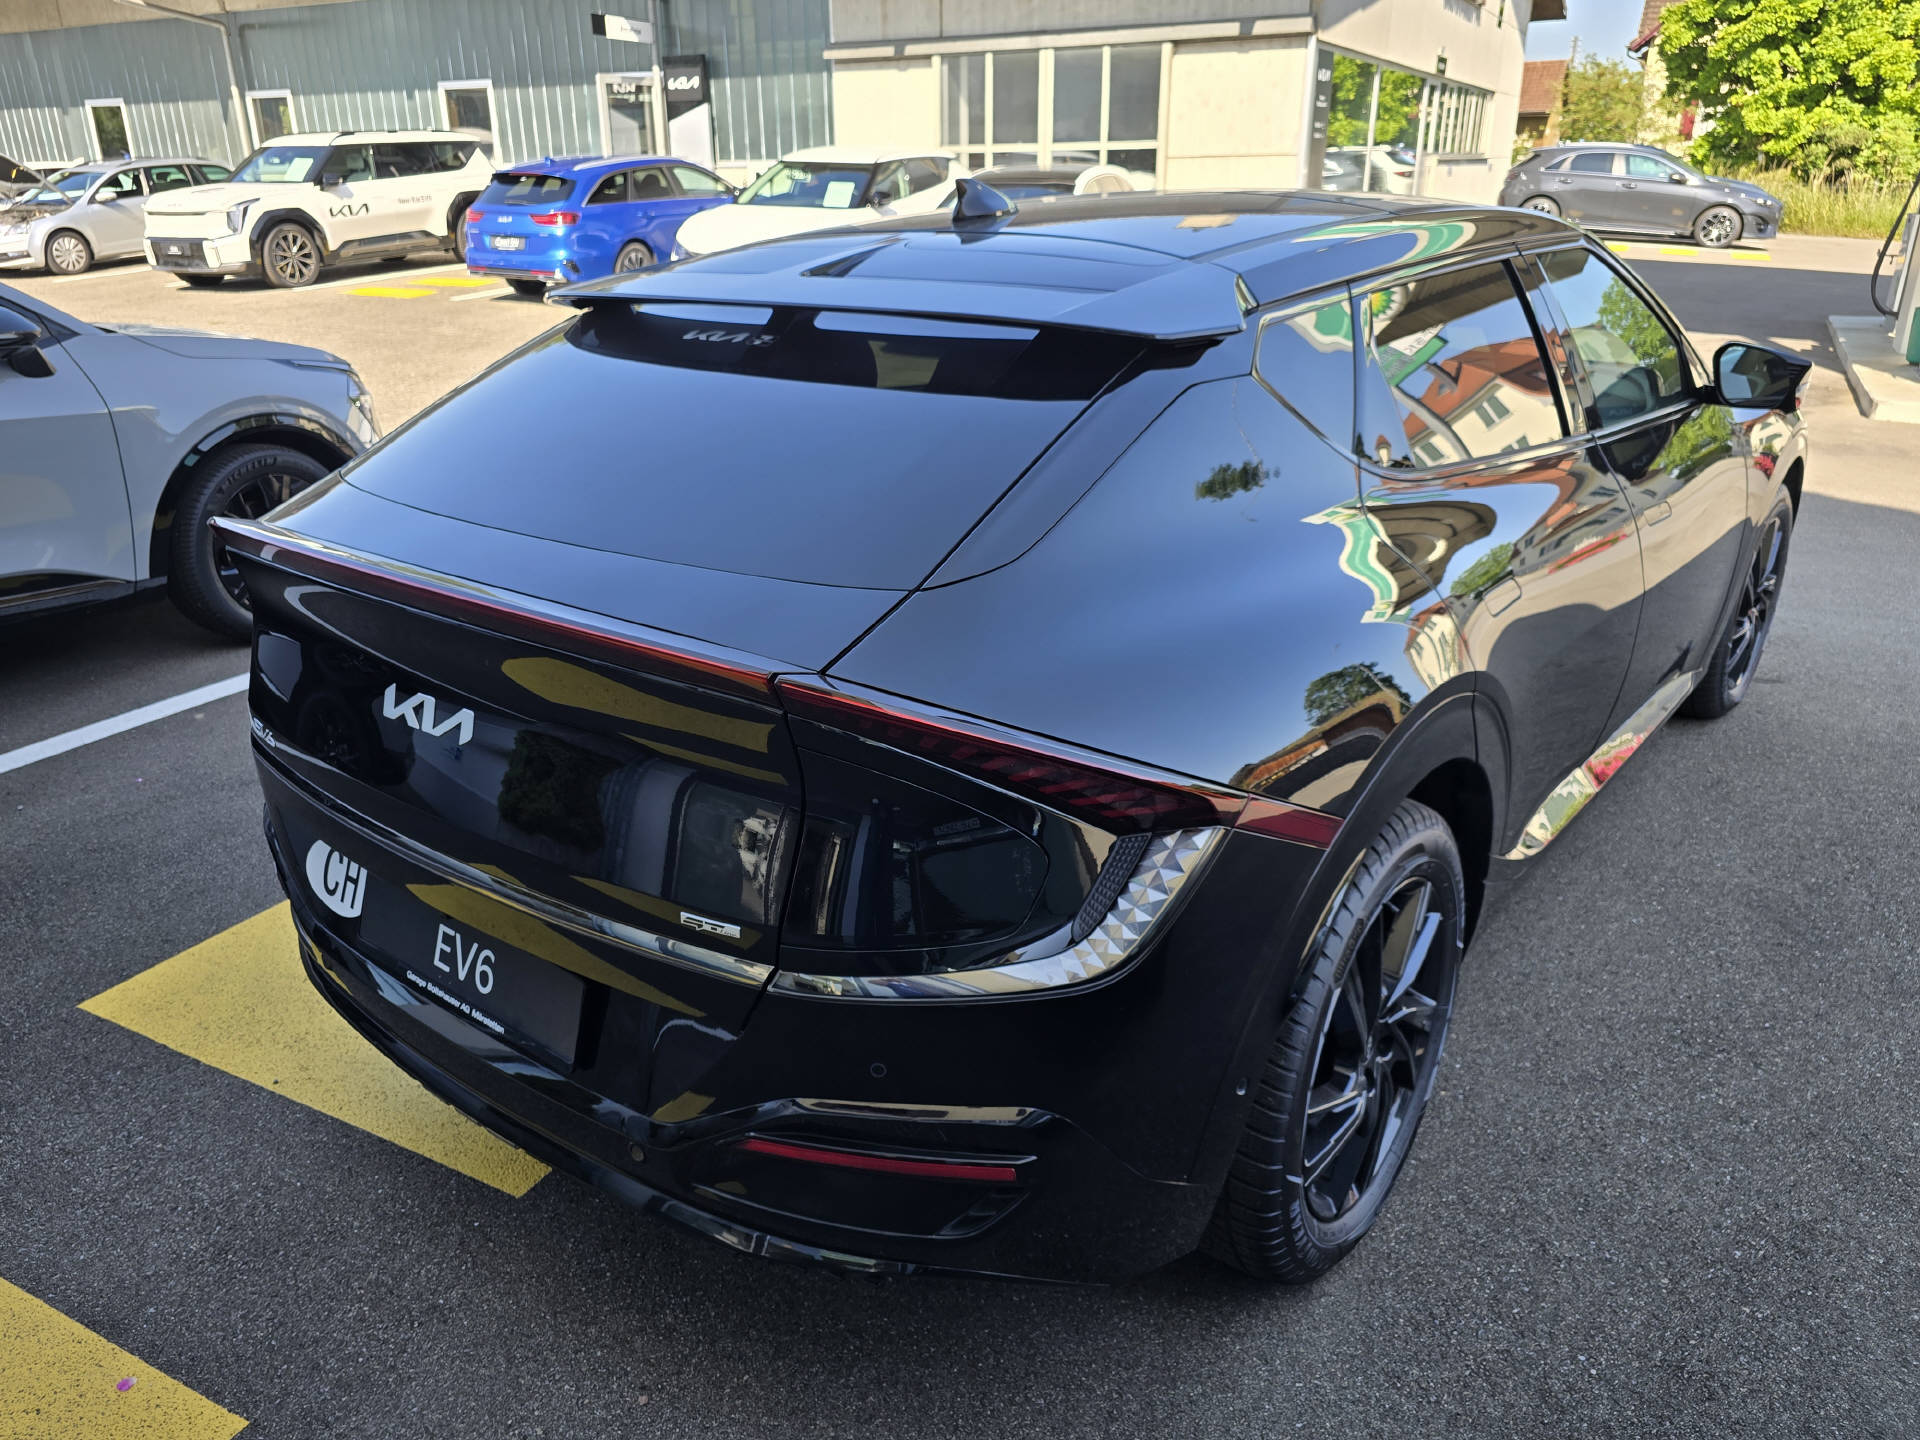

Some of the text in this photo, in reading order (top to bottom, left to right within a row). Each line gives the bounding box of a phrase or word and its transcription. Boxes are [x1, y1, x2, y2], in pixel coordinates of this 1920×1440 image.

[667, 75, 700, 90] KIA
[329, 203, 369, 217] KIA
[383, 682, 475, 746] KIA
[434, 923, 496, 995] EV6
